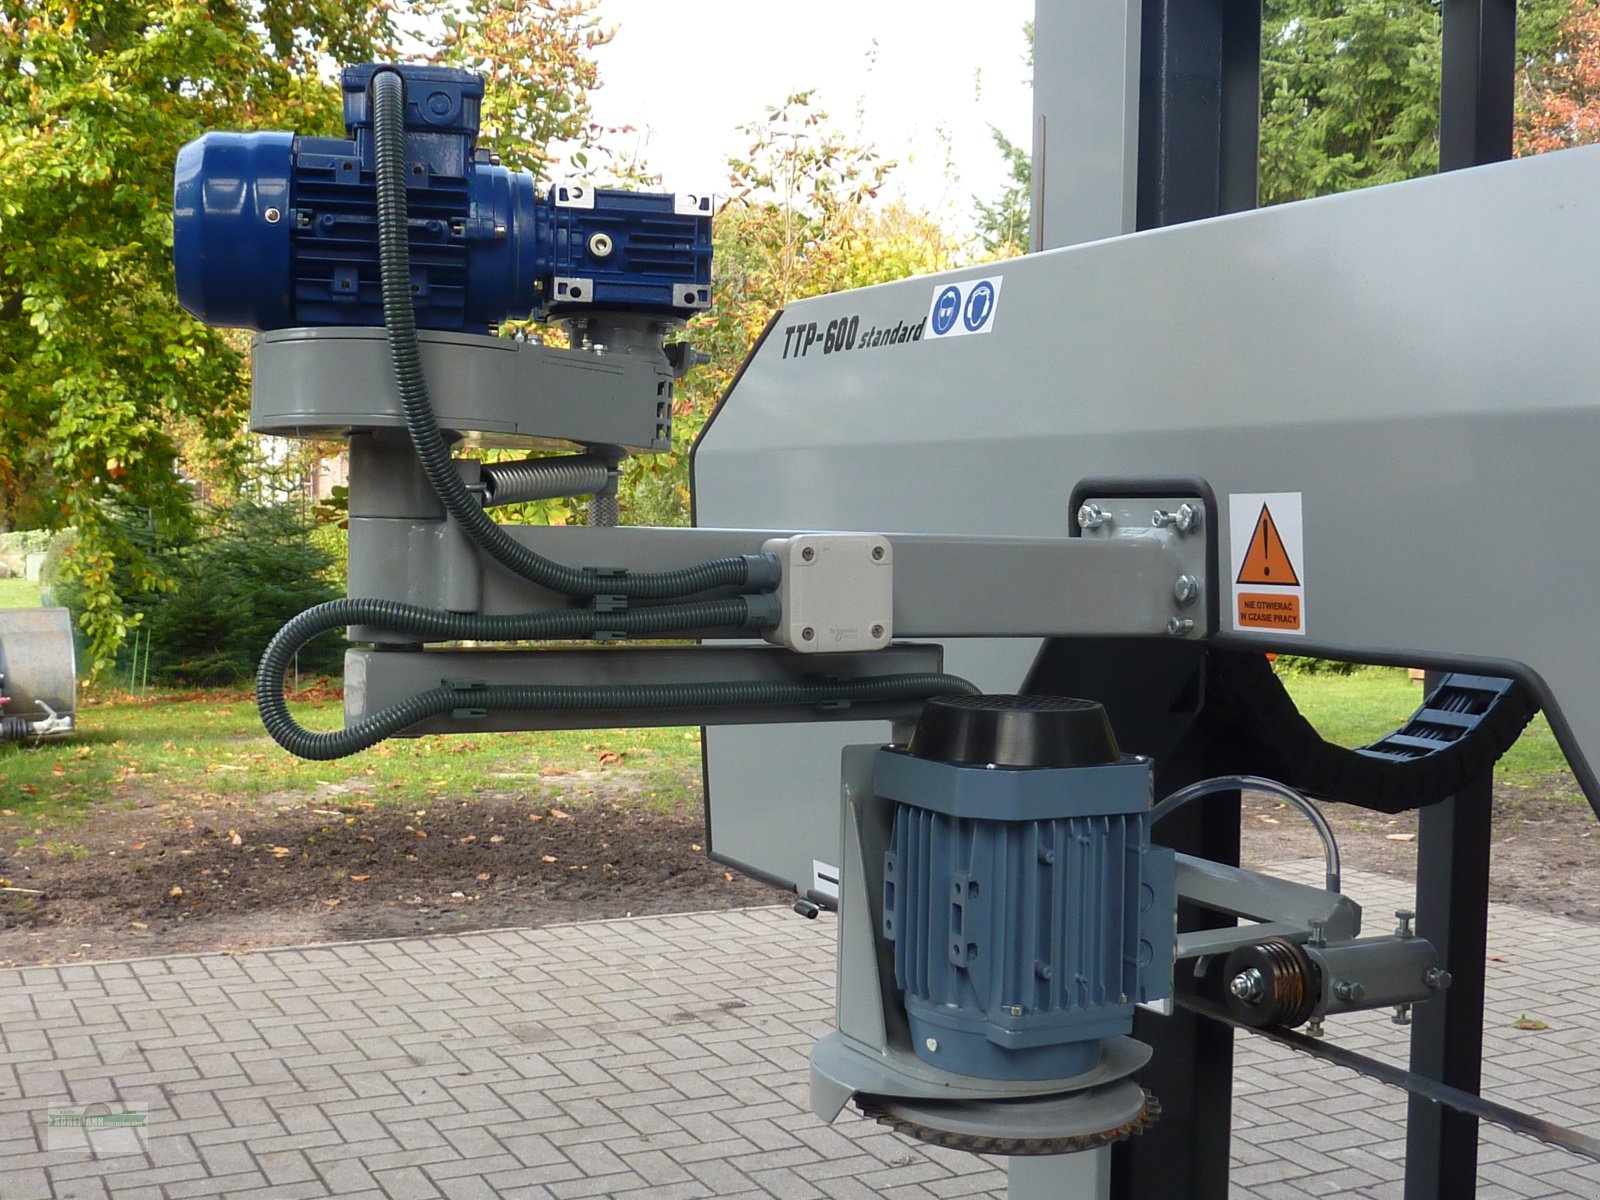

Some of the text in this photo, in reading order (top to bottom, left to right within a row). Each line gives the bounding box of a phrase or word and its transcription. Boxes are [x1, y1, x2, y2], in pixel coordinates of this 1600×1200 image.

[782, 315, 927, 359] TTP-600 standard
[1244, 600, 1293, 611] NIE OTWIERAĆ
[1240, 612, 1298, 624] W CZASIE PRACY
